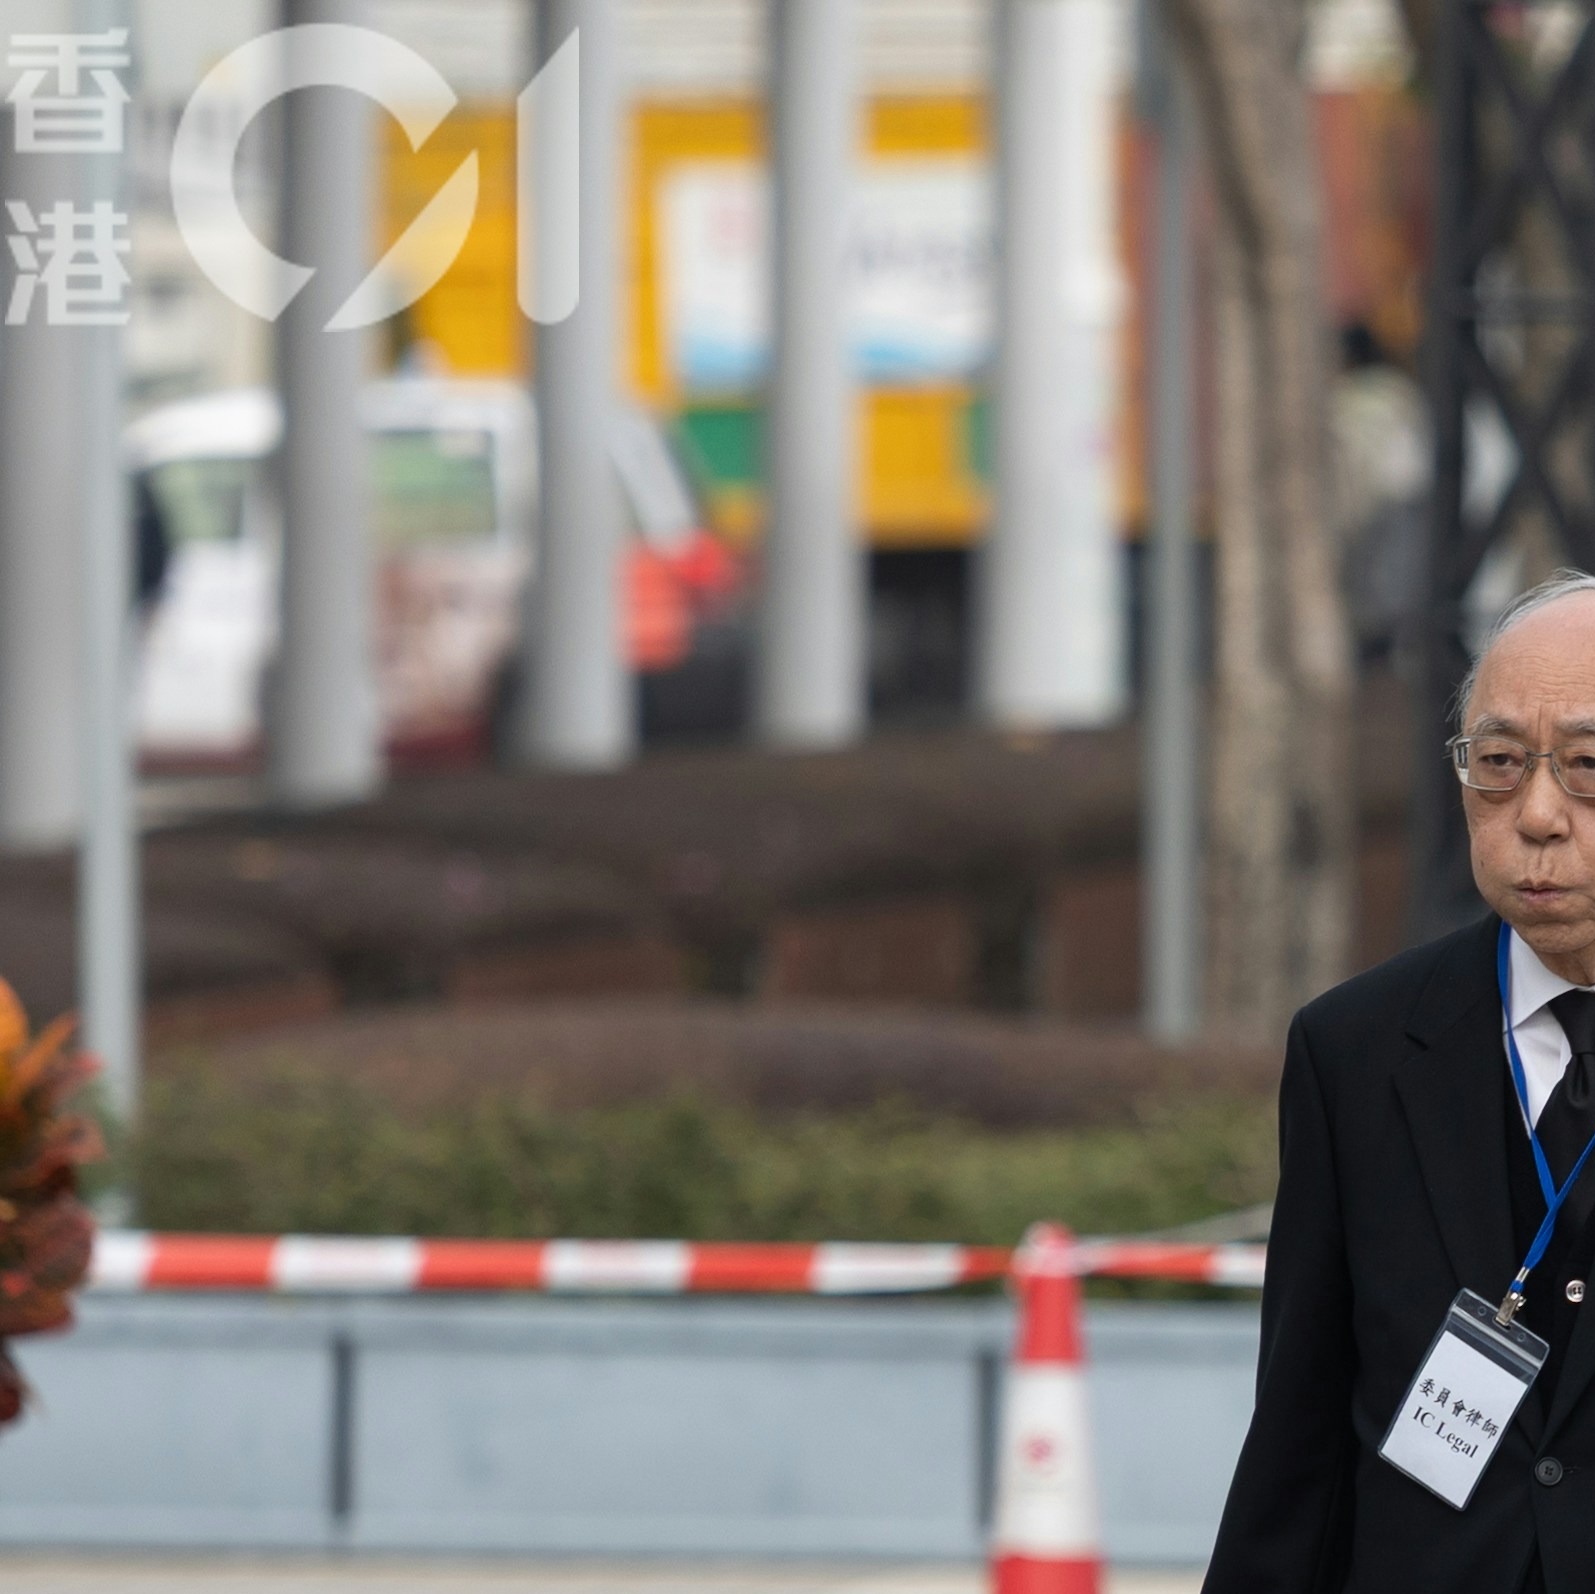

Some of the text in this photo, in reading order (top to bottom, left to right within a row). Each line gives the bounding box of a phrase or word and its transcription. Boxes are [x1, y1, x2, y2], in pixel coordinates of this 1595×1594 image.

[1413, 1406, 1479, 1458] IC Legal
[1419, 1377, 1499, 1439] 委員會律師
